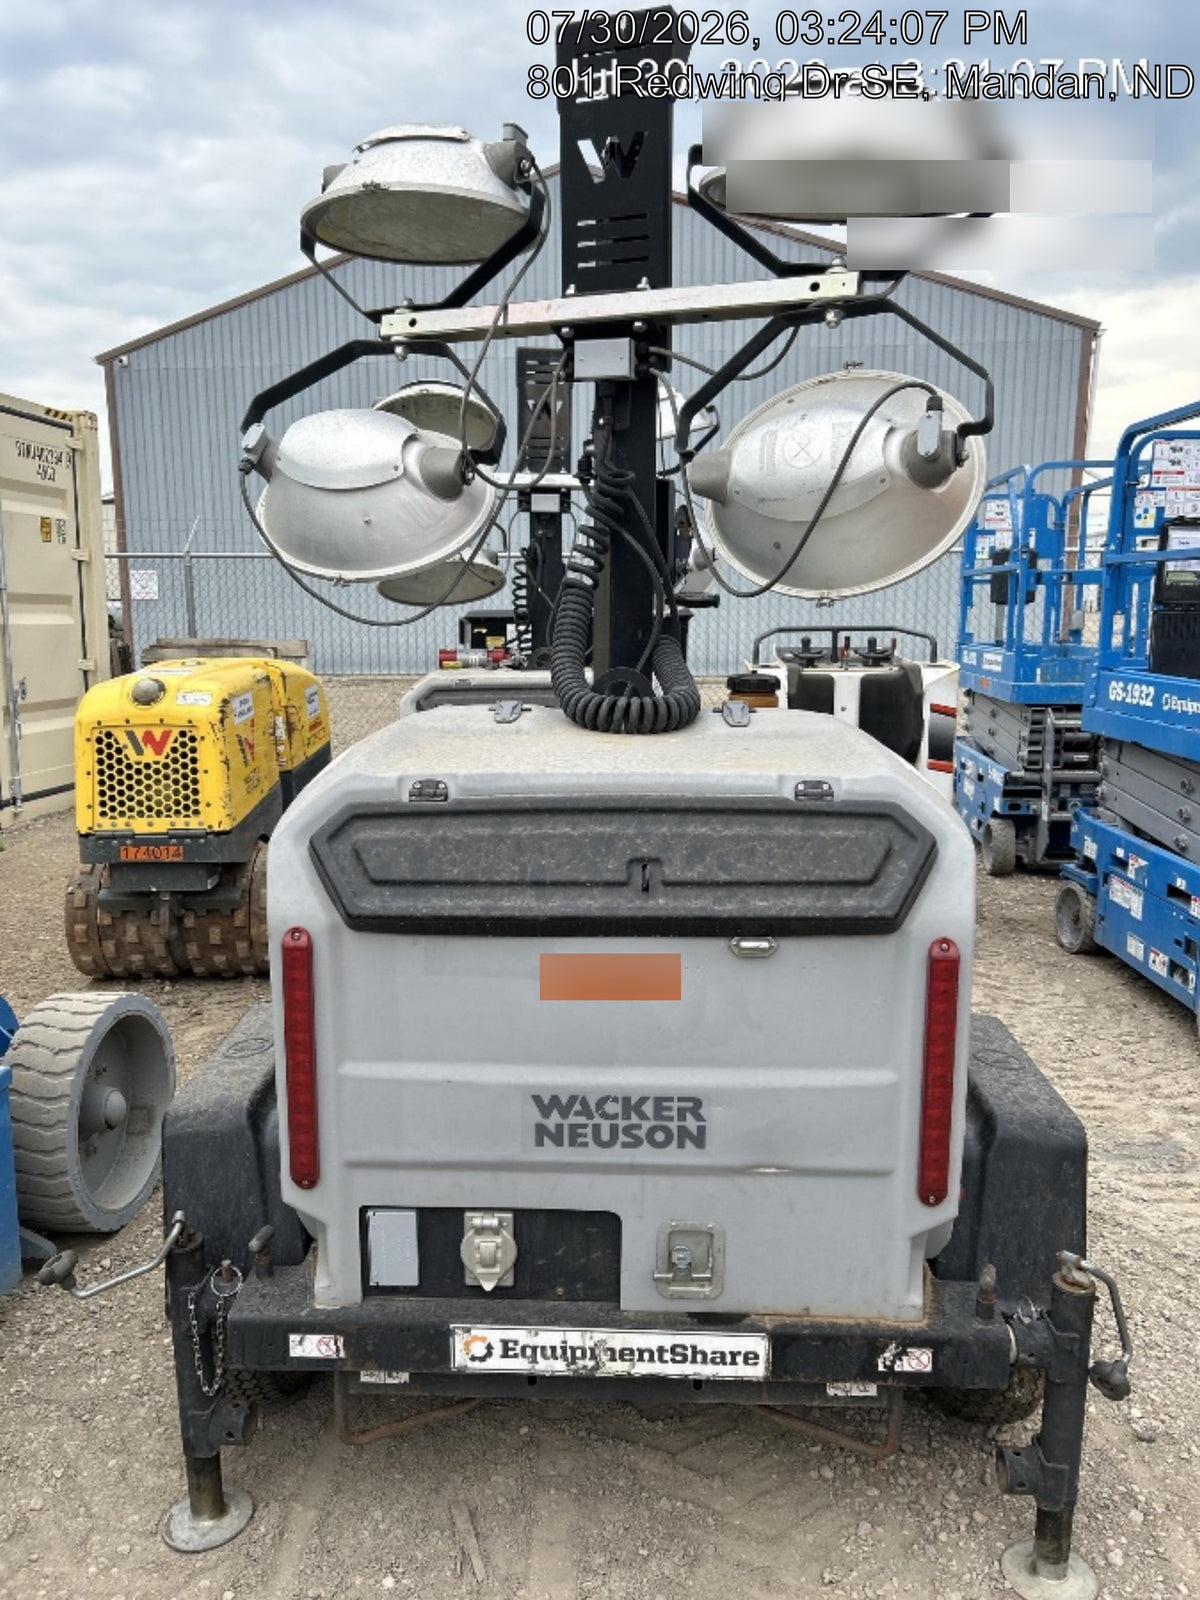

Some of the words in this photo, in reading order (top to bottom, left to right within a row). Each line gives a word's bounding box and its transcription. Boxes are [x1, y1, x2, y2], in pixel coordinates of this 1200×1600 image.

[1108, 680, 1155, 708] GS-1932
[531, 1094, 707, 1122] WACKER
[534, 1123, 707, 1149] NEUSON
[499, 1338, 760, 1367] EquipmentShare
